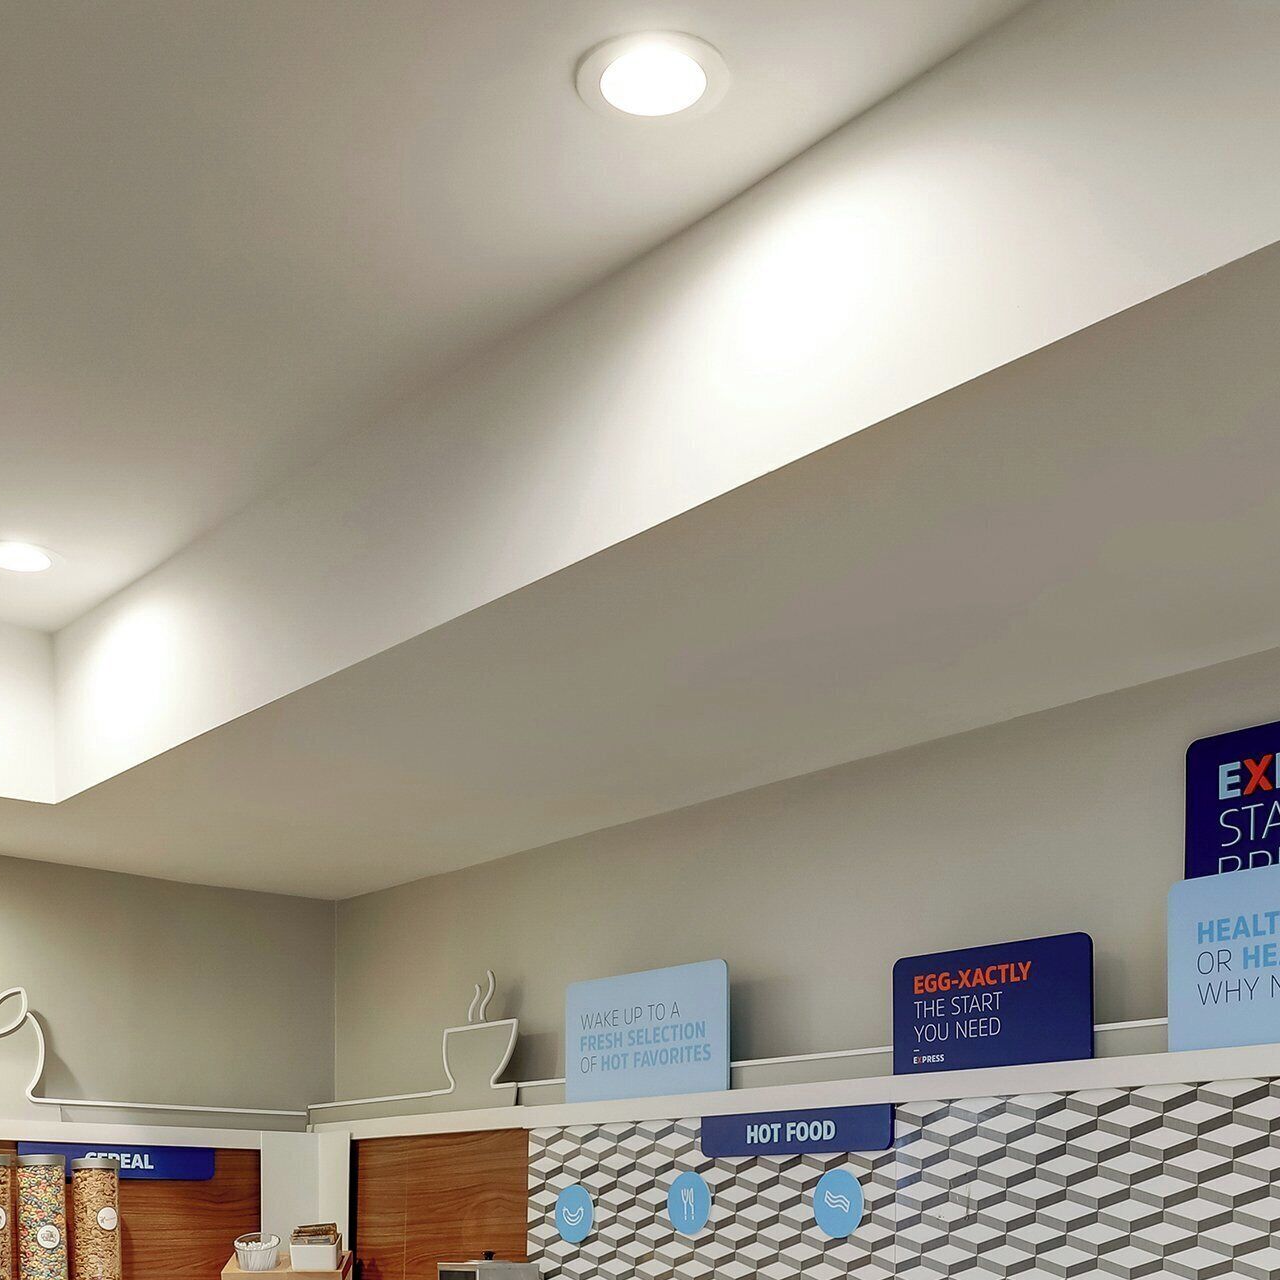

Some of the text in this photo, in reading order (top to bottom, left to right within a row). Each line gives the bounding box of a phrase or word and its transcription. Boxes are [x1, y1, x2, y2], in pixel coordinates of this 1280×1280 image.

[1197, 949, 1232, 975] OR
[913, 960, 1032, 995] EGG-XACTLY
[1197, 976, 1260, 1006] WHY
[580, 1001, 681, 1031] WAKE UP TO A
[913, 991, 1003, 1019] THE START
[580, 1020, 706, 1053] FRESH SELECTION
[913, 1017, 1001, 1043] YOU NEED
[580, 1043, 712, 1074] OF HOT FAVORITES
[913, 1054, 945, 1065] EXPRESS
[746, 1119, 837, 1145] HOT FOOD
